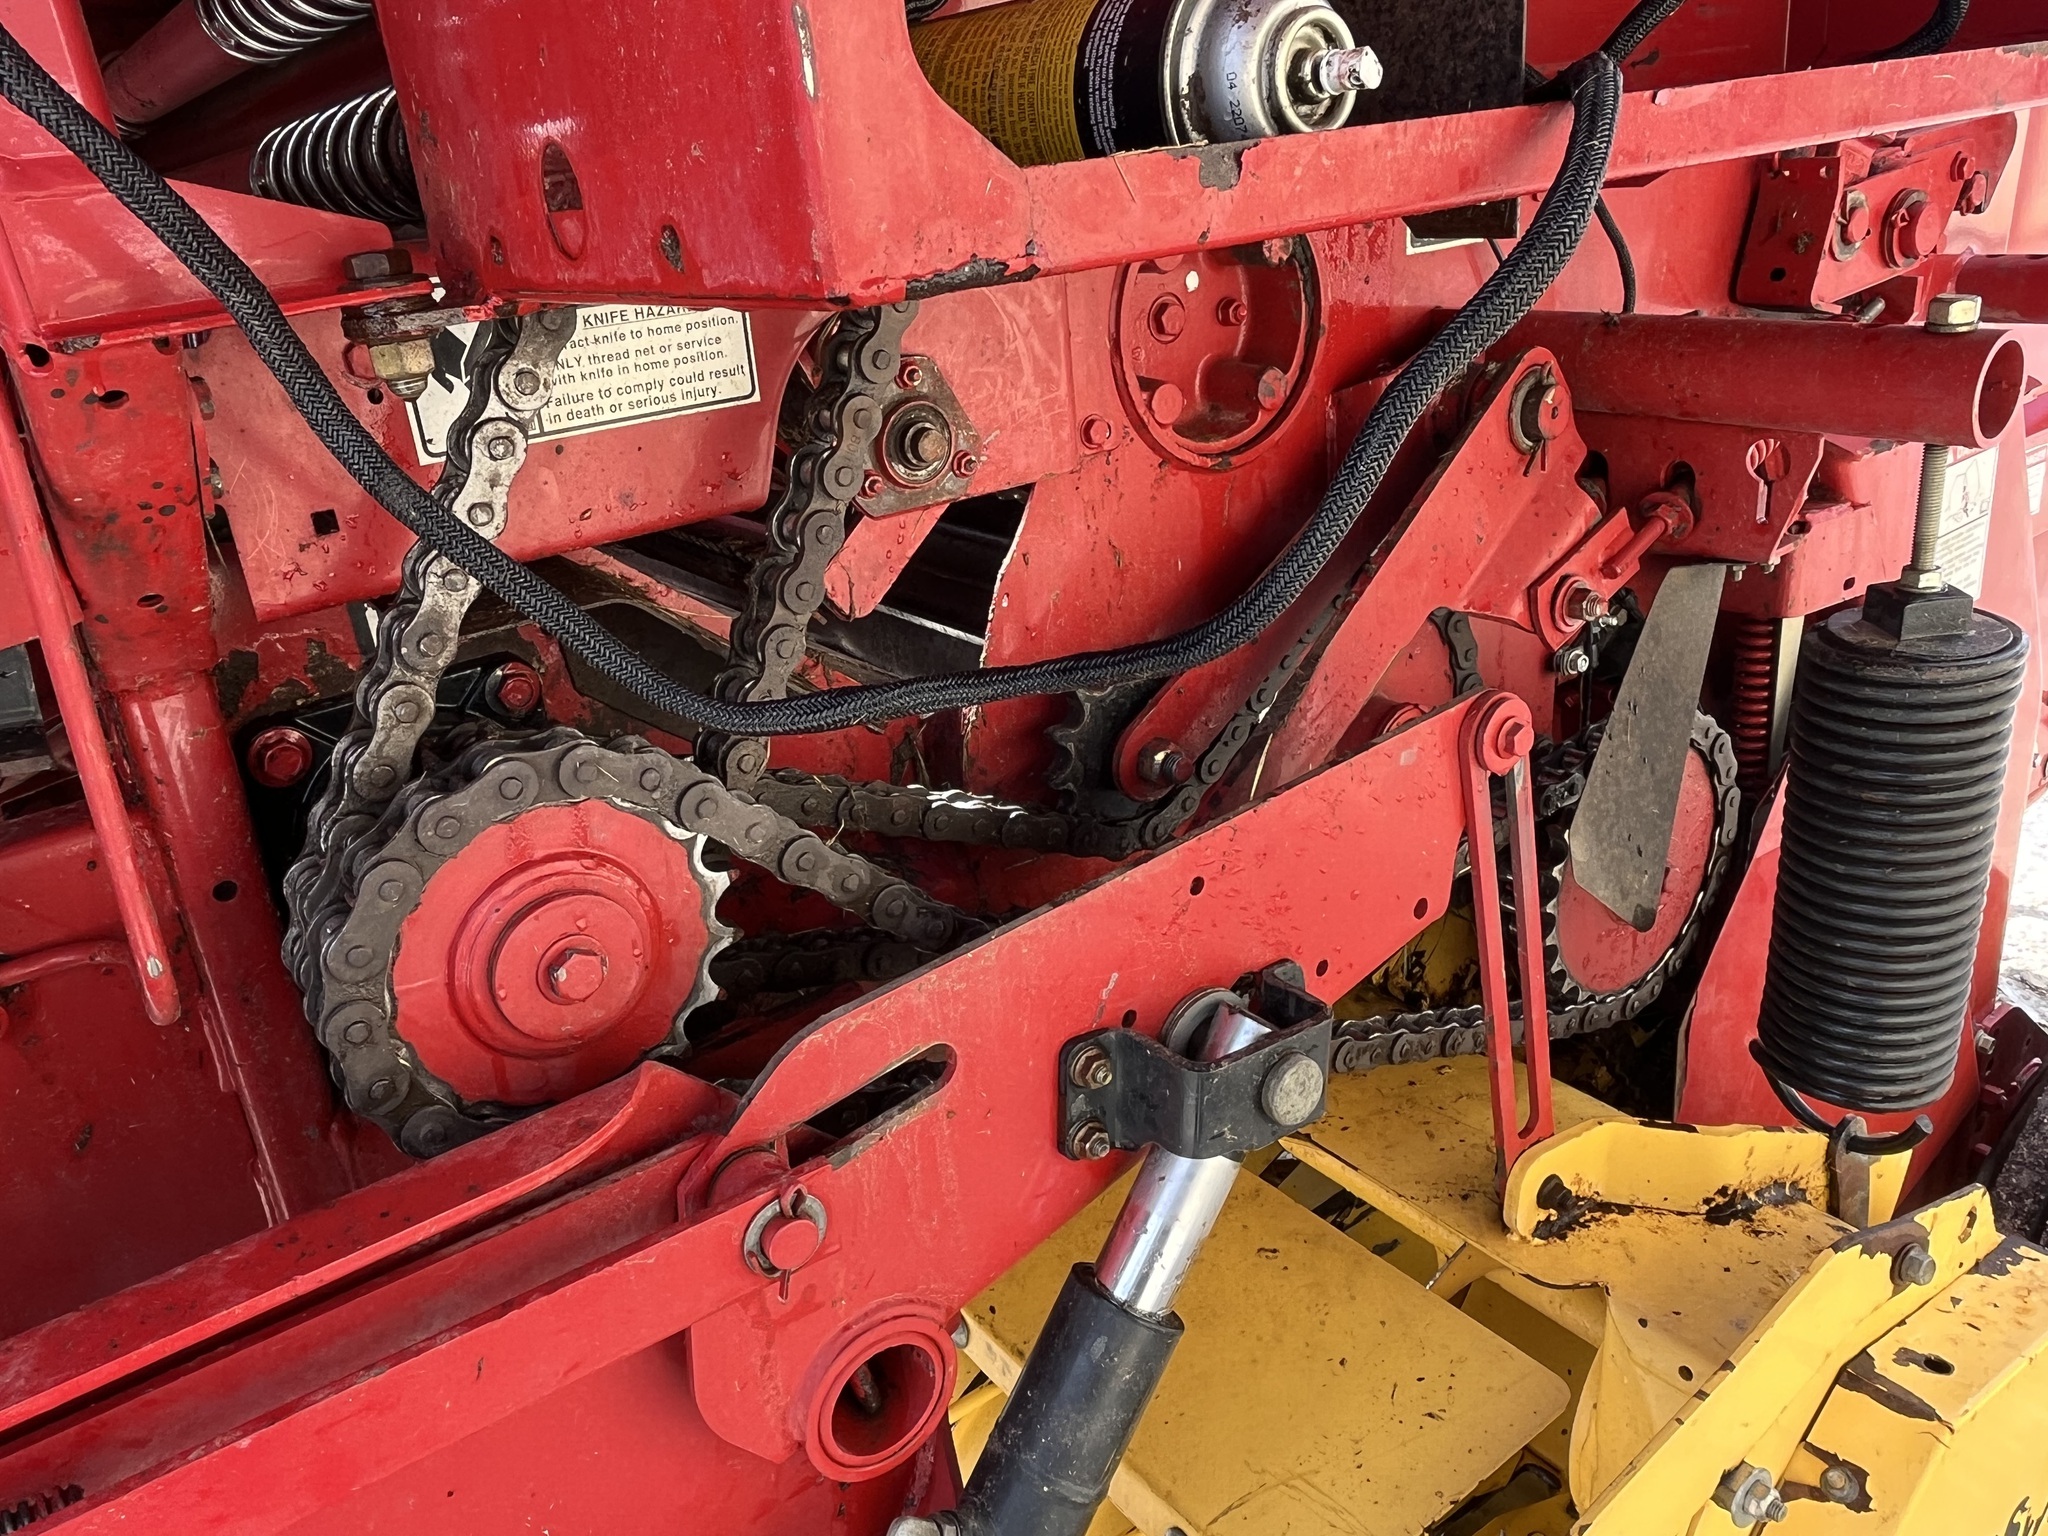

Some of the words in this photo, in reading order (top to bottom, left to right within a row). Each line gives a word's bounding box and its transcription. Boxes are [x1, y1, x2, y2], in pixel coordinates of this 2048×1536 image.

[1226, 71, 1238, 90] 04
[582, 309, 629, 327] KNIFE
[634, 305, 692, 320] HAZA
[593, 329, 626, 346] knife
[630, 328, 643, 339] to
[647, 324, 682, 337] home
[686, 316, 738, 333] position.
[556, 355, 582, 370] NLY
[587, 349, 629, 365] thread
[635, 345, 655, 358] net
[659, 343, 673, 354] or
[677, 336, 722, 351] service
[617, 364, 630, 375] in
[634, 359, 669, 372] home
[673, 350, 728, 369] position.
[598, 387, 612, 400] to
[616, 378, 664, 395] comply
[669, 370, 705, 387] could
[709, 364, 746, 380] result
[548, 412, 561, 424] in
[566, 404, 604, 421] death
[609, 402, 623, 413] or
[628, 392, 677, 410] serious
[681, 386, 722, 401] injury.
